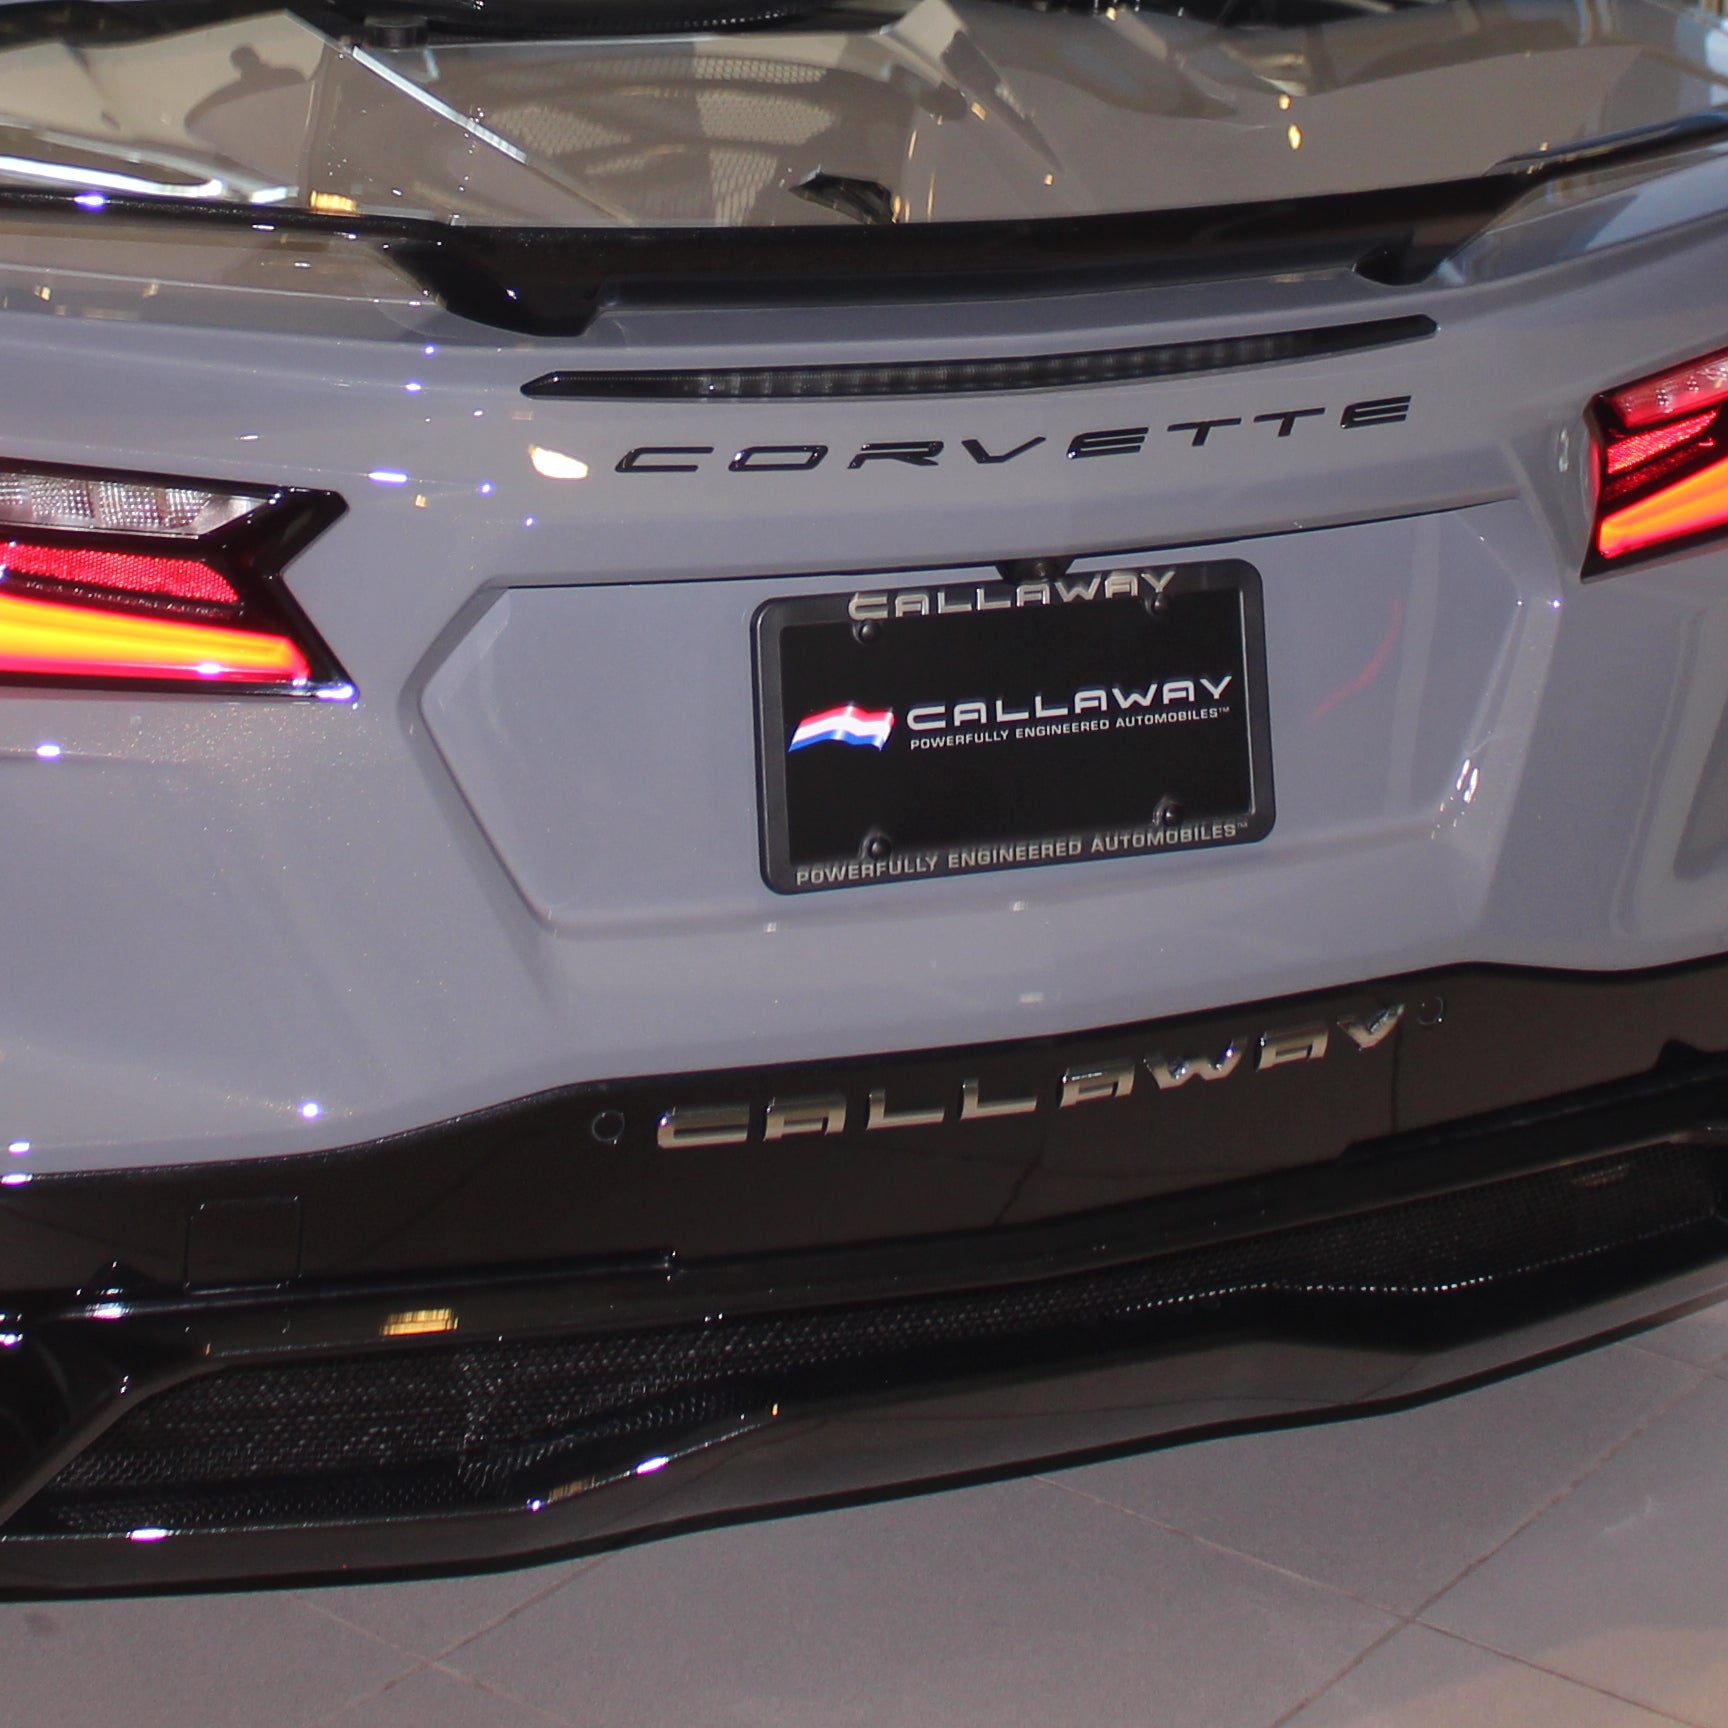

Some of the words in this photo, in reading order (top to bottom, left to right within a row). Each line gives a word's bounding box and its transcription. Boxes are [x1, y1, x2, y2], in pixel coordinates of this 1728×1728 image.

[614, 395, 1412, 473] CORVETTE
[848, 569, 1175, 620] CALLAWAY
[906, 675, 1233, 731] CALLAWAY
[910, 729, 1009, 751] POWERFULLY
[1015, 718, 1110, 739] ENGINEERED
[795, 855, 939, 886] POWERFULLY
[947, 839, 1082, 869] ENGINEERED
[656, 1002, 1406, 1150] CALLAWAY
